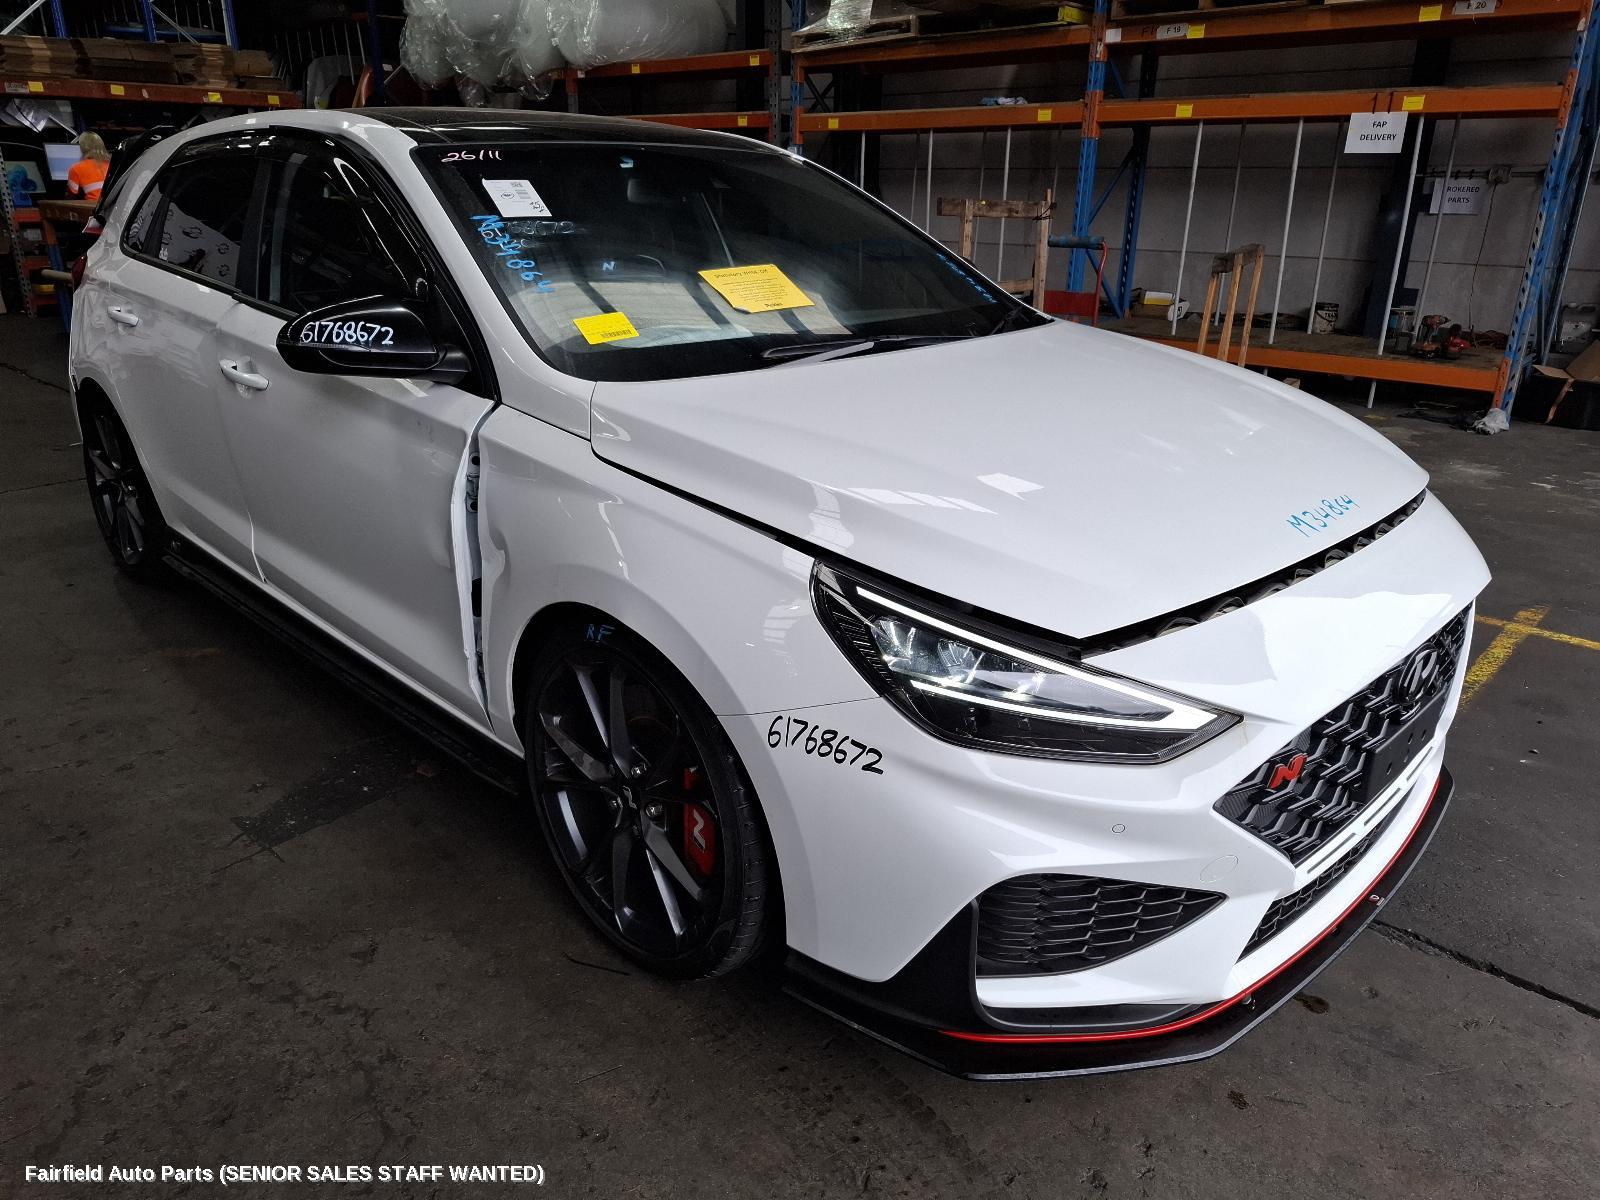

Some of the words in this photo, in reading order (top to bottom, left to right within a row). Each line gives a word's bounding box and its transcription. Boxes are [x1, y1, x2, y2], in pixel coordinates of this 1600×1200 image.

[1372, 120, 1388, 128] FAP
[1359, 133, 1397, 141] DELIVERY
[441, 150, 502, 163] 26/11
[300, 321, 394, 345] 61768672
[767, 715, 884, 775] 61768672
[1266, 752, 1308, 789] N
